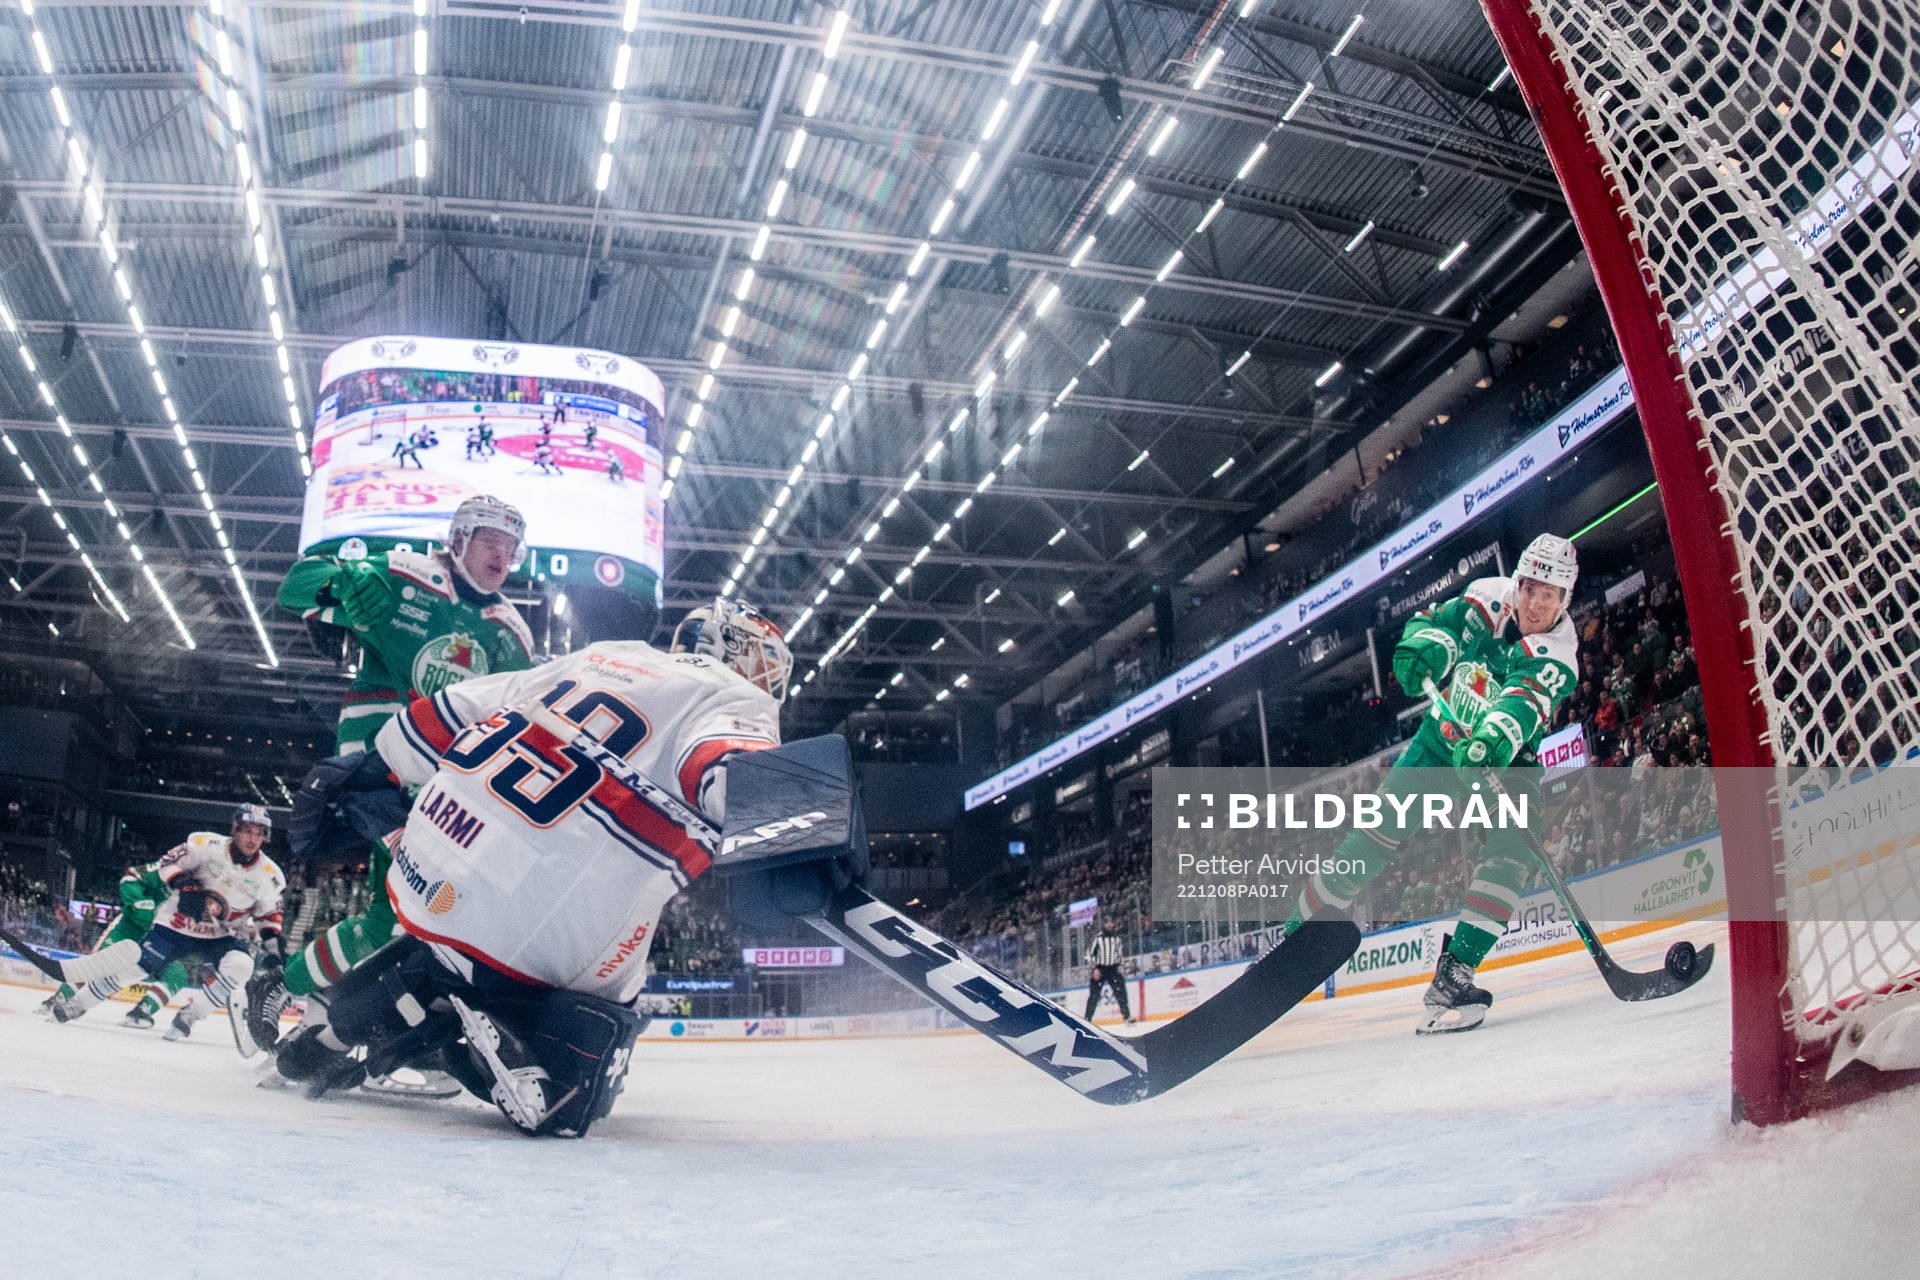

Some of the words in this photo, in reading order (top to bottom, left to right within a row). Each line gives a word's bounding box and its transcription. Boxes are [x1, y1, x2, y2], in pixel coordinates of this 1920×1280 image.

[418, 784, 485, 850] LARMI
[1501, 901, 1570, 936] JÄR
[1347, 938, 1423, 975] AGRIZON
[1495, 924, 1573, 952] MARKKONSULT
[844, 901, 1134, 1095] CCM
